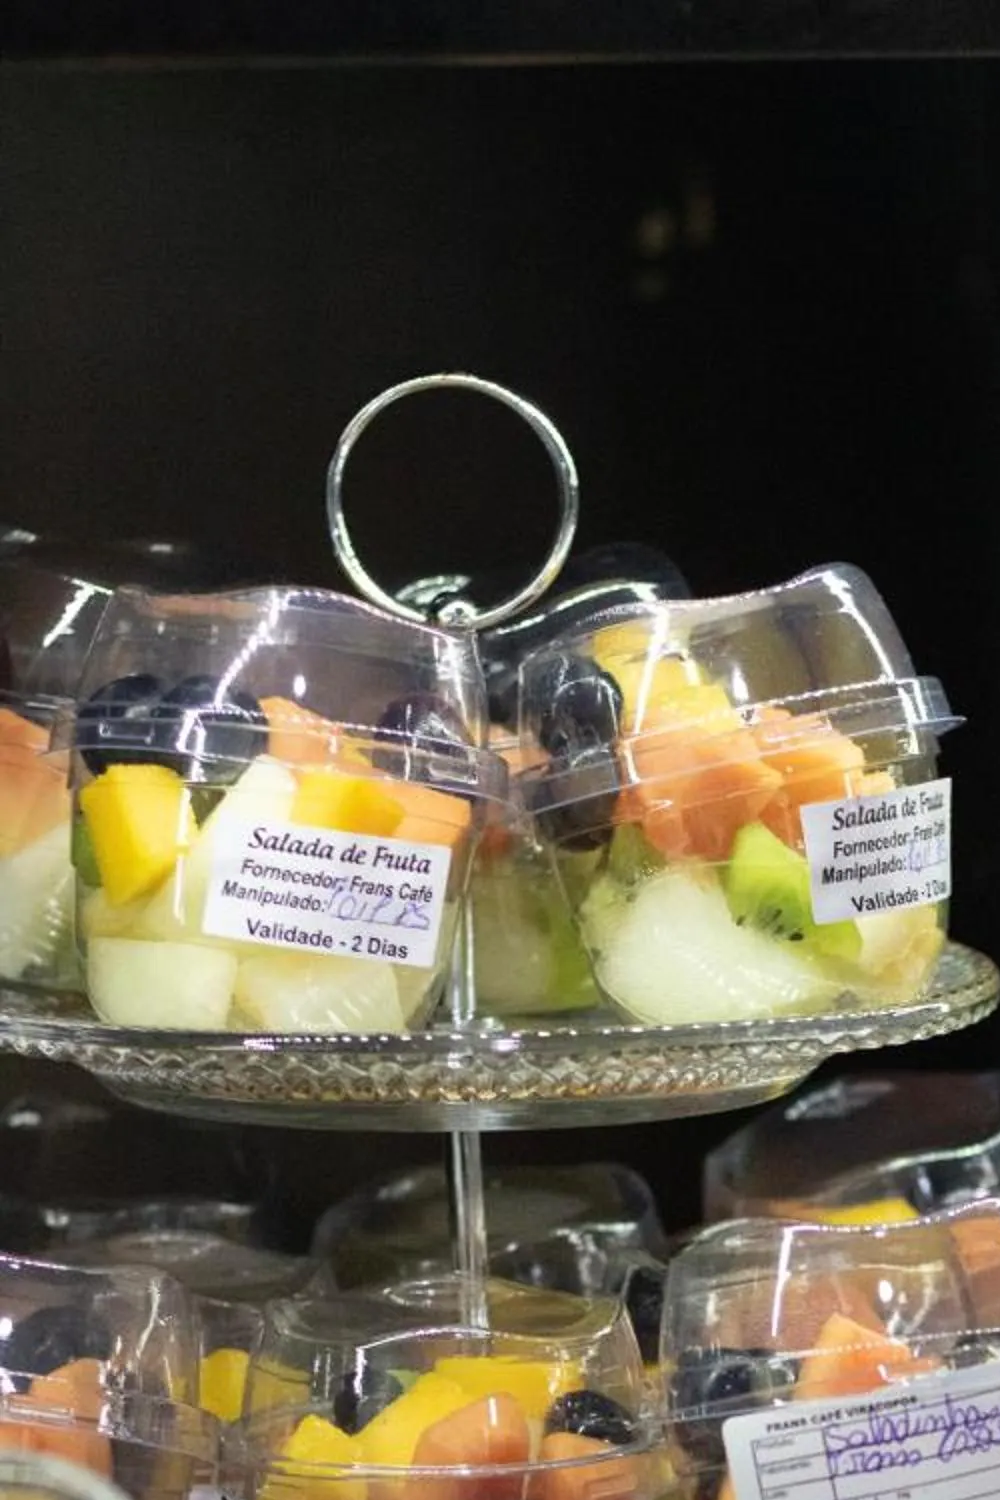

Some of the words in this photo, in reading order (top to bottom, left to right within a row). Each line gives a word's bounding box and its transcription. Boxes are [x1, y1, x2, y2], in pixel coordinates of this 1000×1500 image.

[832, 801, 897, 831] Salada
[901, 796, 917, 818] de
[248, 827, 334, 861] Salada
[340, 843, 367, 866] de
[372, 846, 431, 875] Fruta
[821, 854, 907, 885] Manipulado:
[221, 879, 327, 913] Manipulado:
[349, 876, 394, 898] Frans
[399, 882, 433, 903] Café
[851, 886, 919, 912] Validade
[246, 918, 334, 949] Validade
[351, 935, 363, 953] 2
[367, 938, 409, 960] Dias
